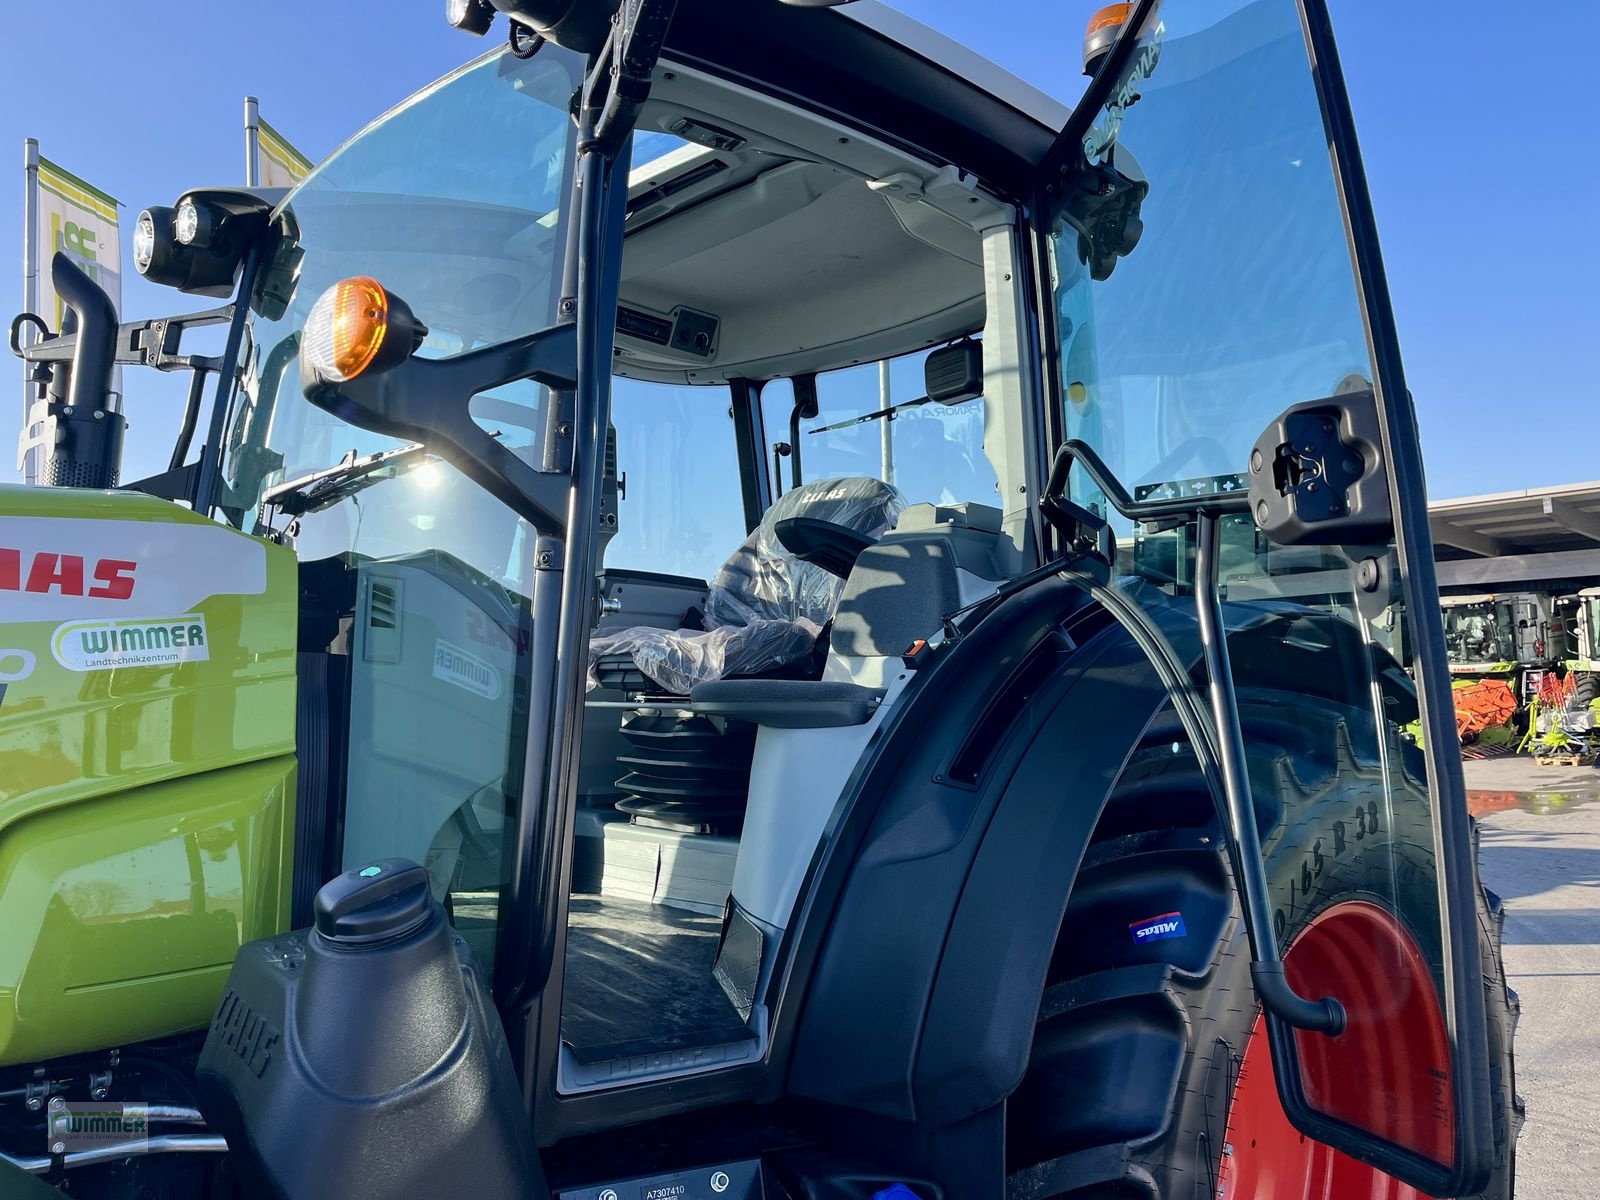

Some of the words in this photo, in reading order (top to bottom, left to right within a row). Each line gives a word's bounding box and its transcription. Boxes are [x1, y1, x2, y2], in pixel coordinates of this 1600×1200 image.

[81, 624, 205, 655] WIMMER
[85, 652, 179, 668] Landtechnikzentrum
[1332, 820, 1346, 858] R
[1355, 800, 1379, 841] 38
[1136, 921, 1179, 938] Mitas
[646, 1185, 685, 1200] A7307410
